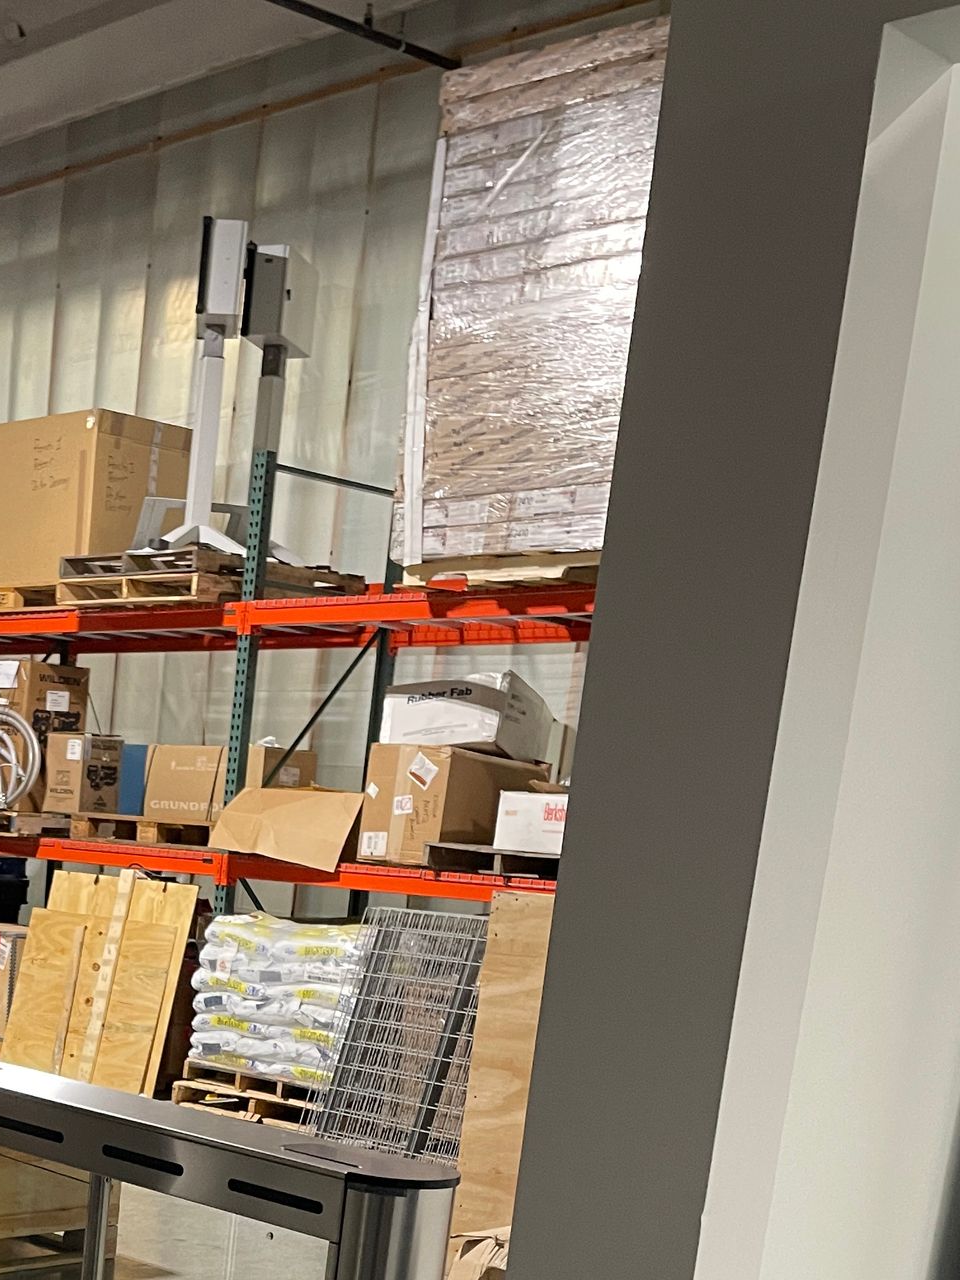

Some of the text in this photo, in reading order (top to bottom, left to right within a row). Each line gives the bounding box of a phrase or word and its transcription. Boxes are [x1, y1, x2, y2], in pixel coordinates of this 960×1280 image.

[39, 674, 80, 686] WILDEN
[407, 688, 472, 704] Rubber Fab
